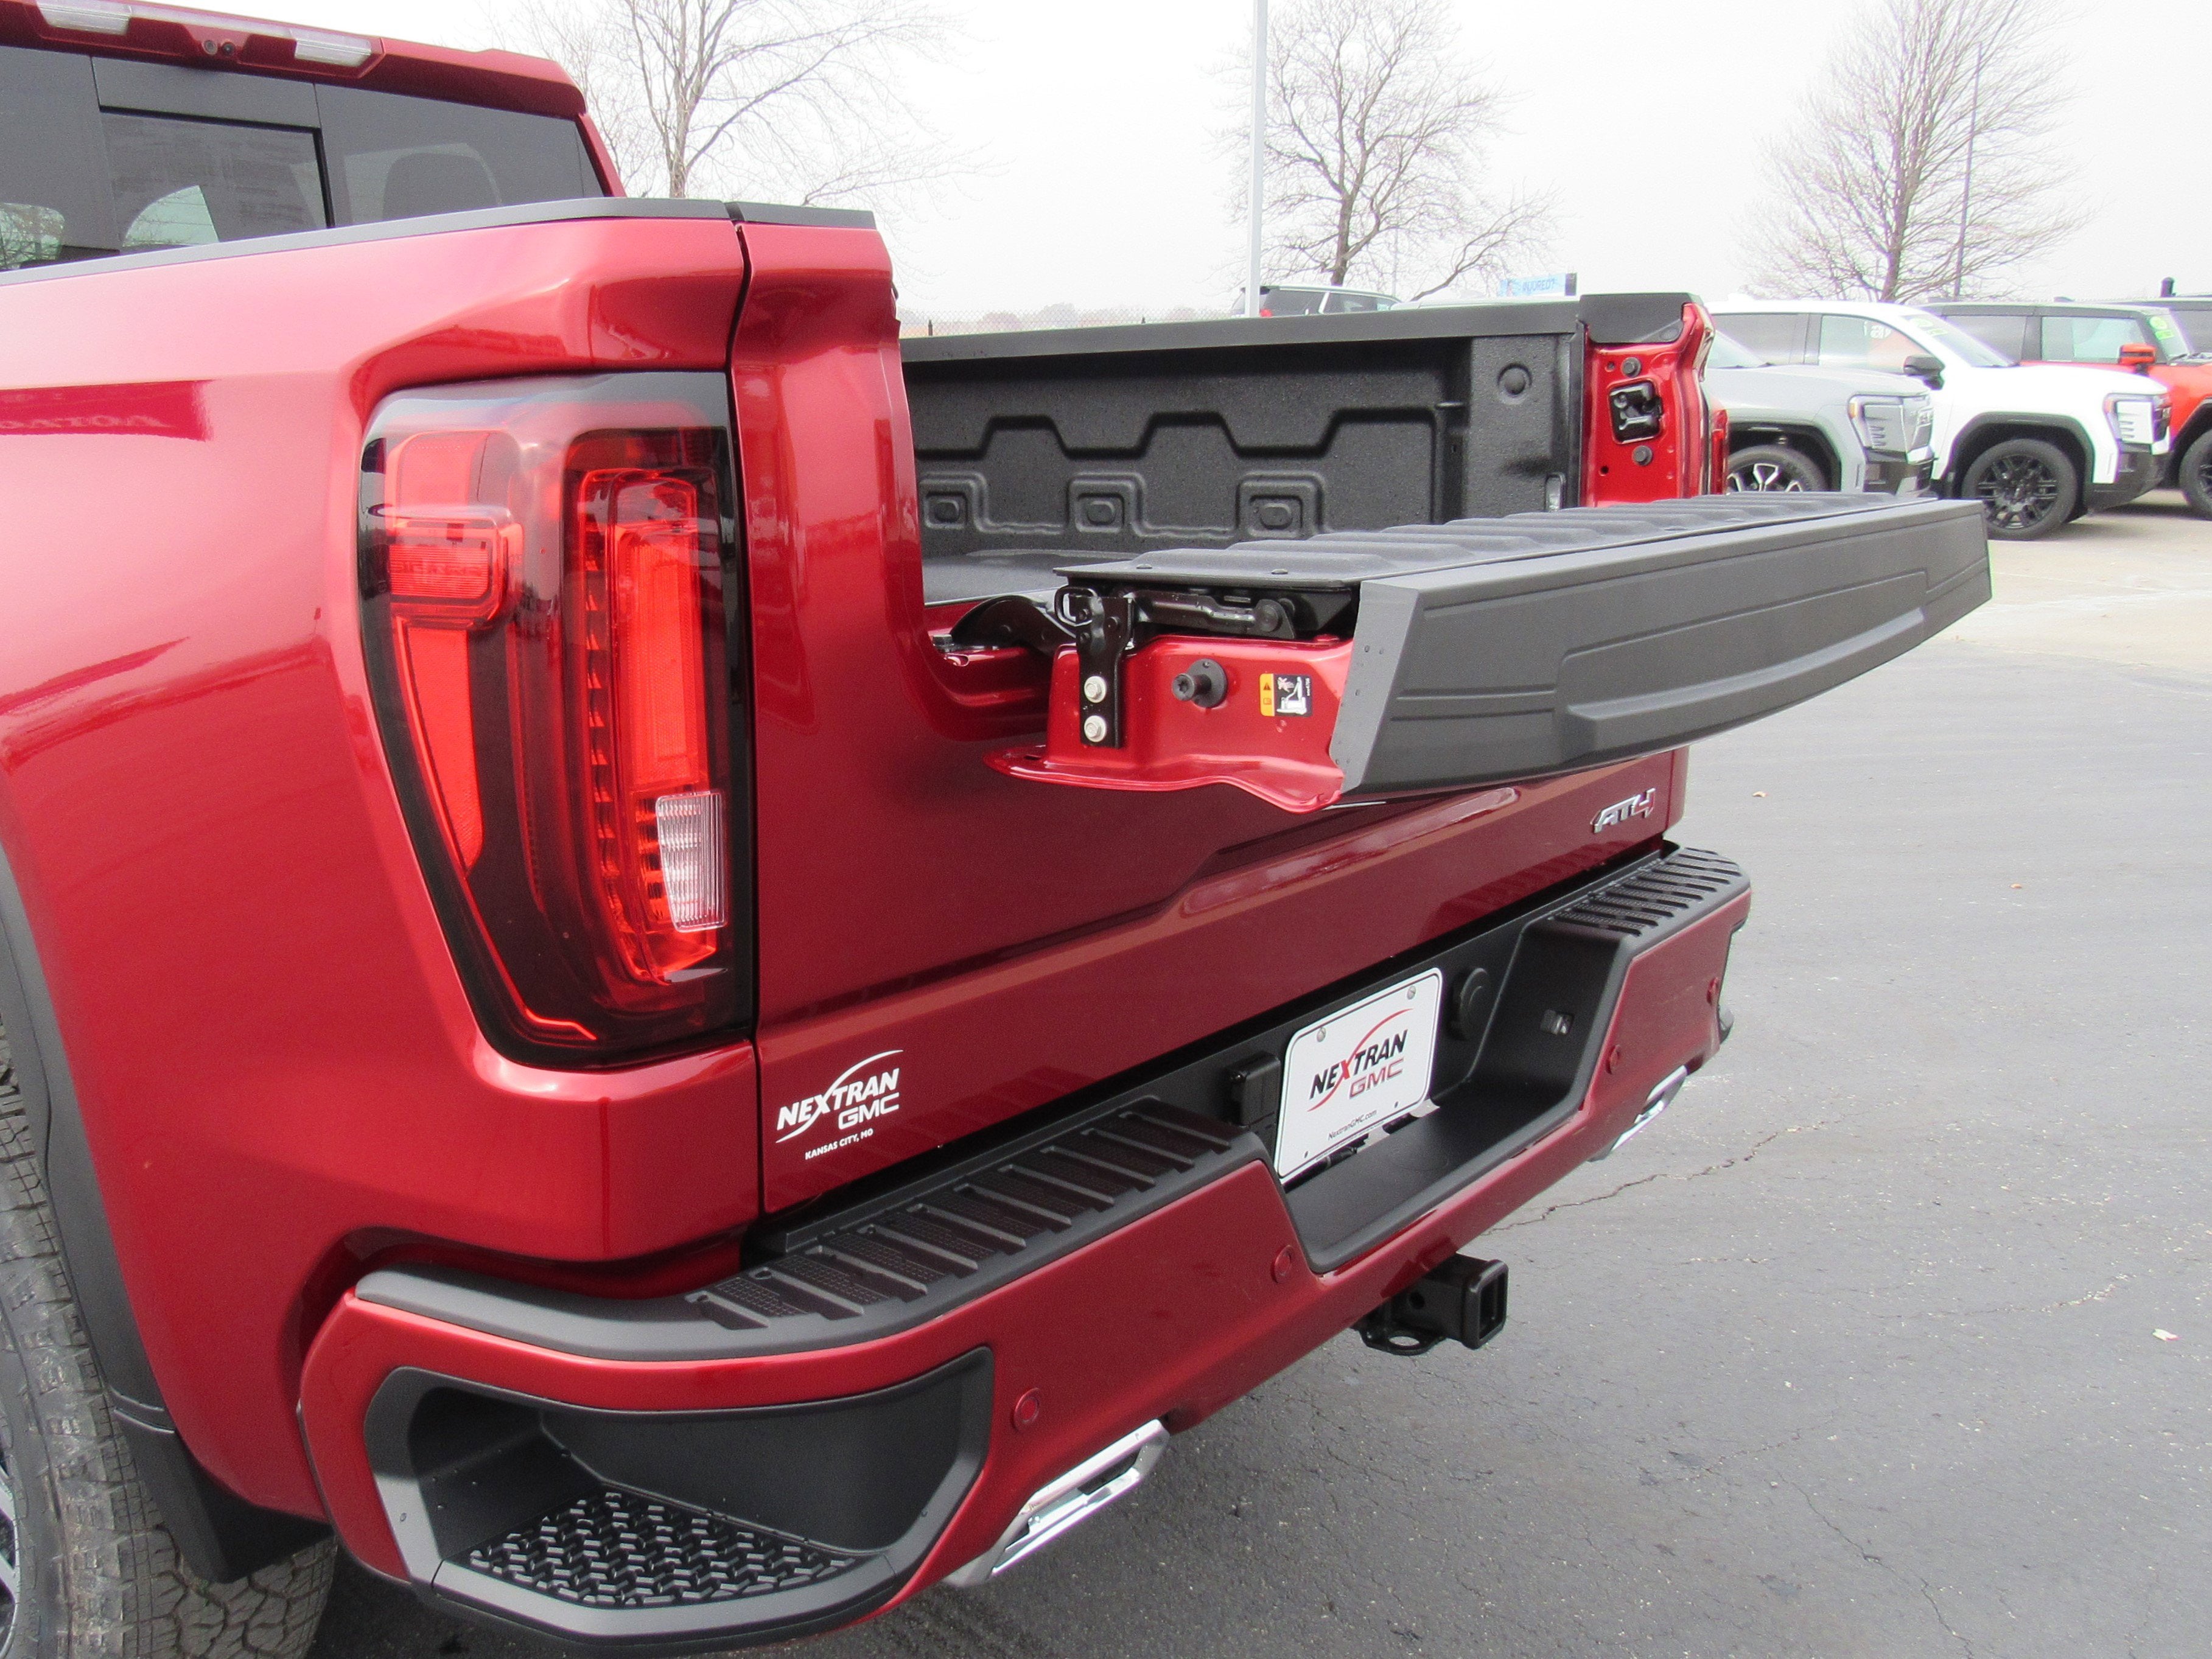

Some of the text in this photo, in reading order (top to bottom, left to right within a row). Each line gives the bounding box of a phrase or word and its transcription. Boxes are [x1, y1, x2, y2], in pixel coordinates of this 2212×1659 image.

[1590, 788, 1656, 833] AT4
[1309, 1029, 1407, 1100] NEXTRAN
[1348, 1057, 1404, 1098] GMC
[776, 1067, 900, 1131] NEXTRAN
[838, 1092, 900, 1130] GMC
[805, 1140, 838, 1161] KANSAS
[861, 1128, 874, 1140] MO
[1328, 1109, 1377, 1140] NextranGMC.com
